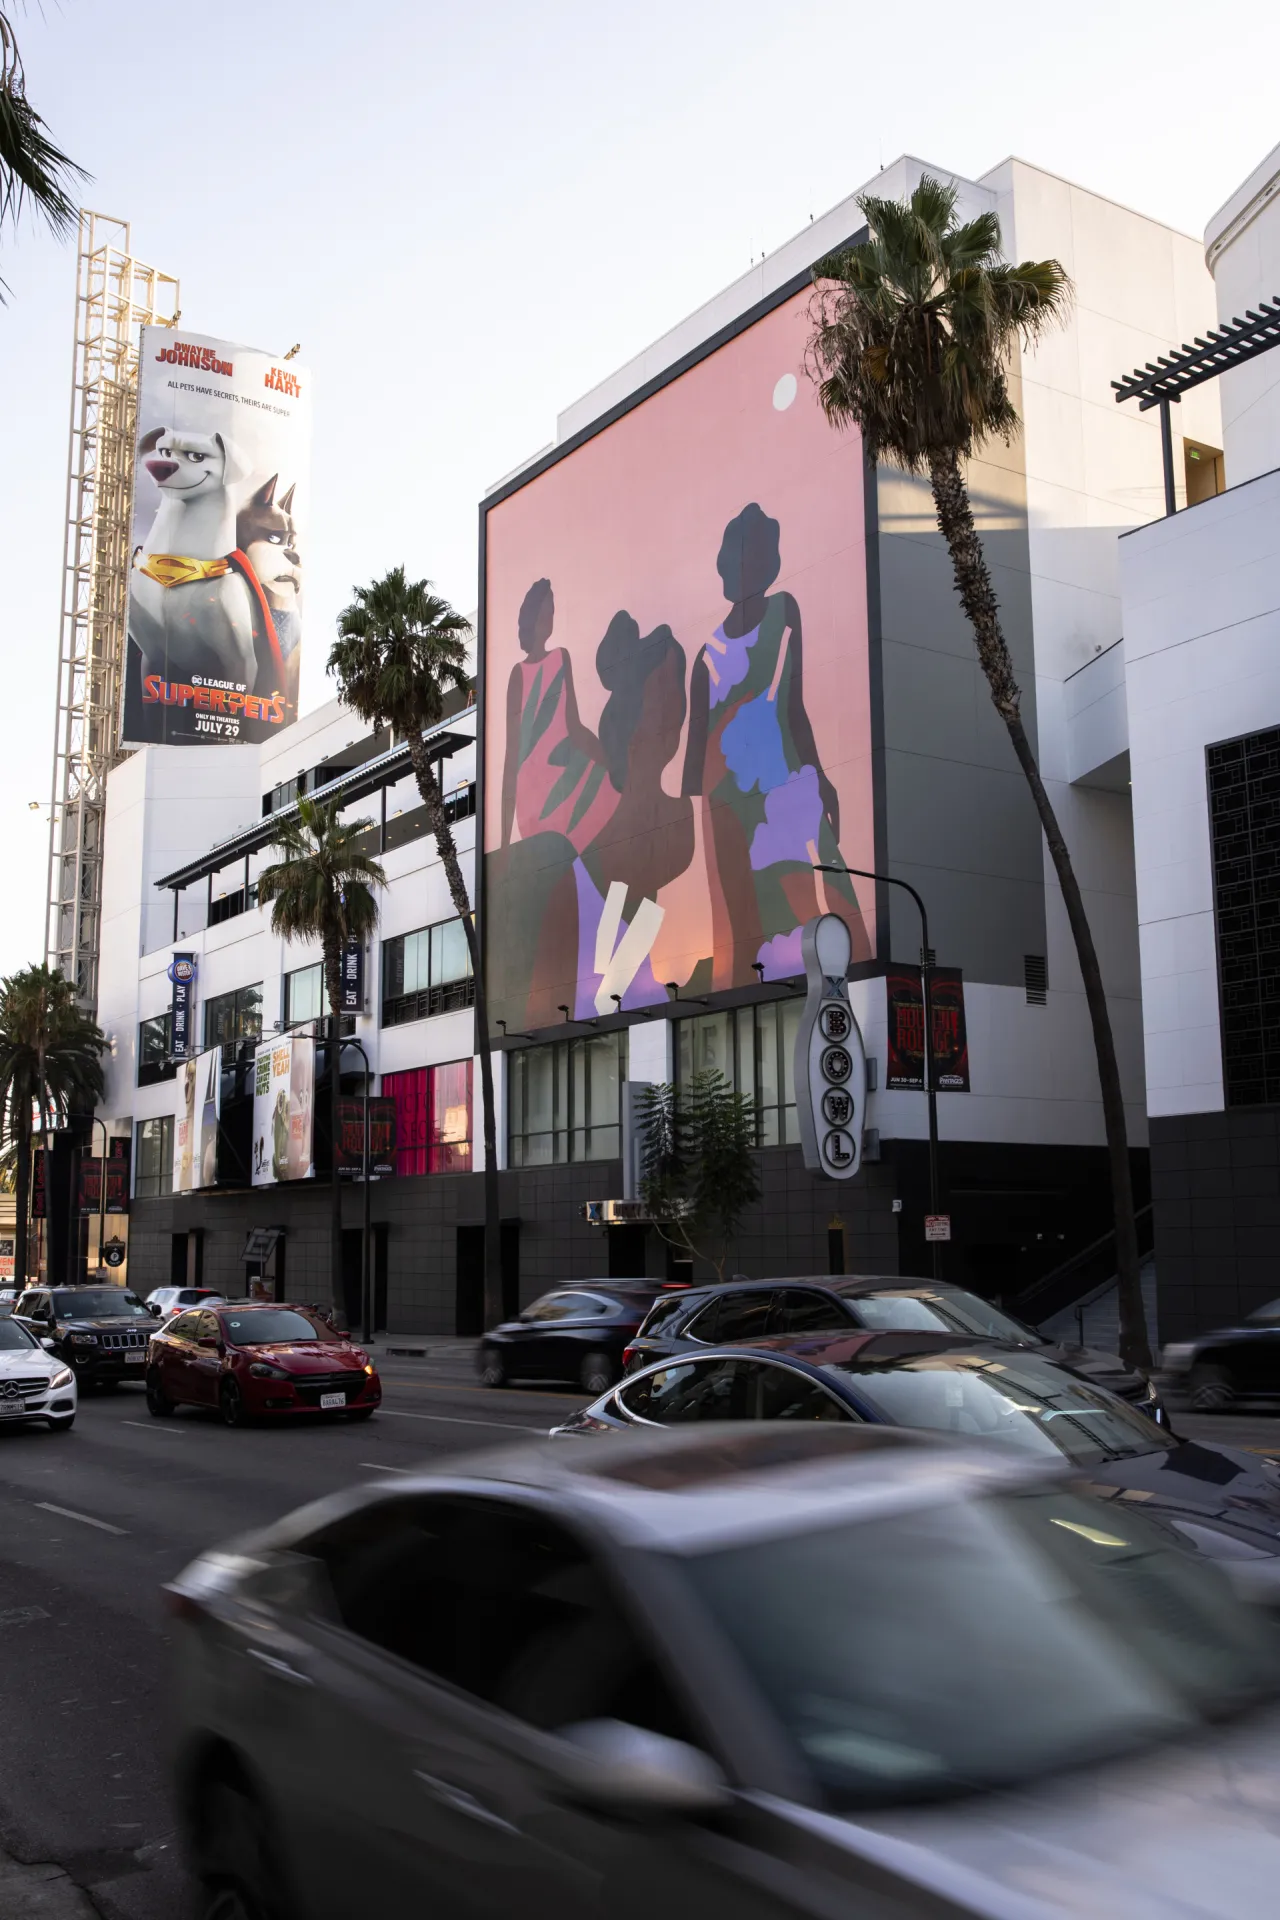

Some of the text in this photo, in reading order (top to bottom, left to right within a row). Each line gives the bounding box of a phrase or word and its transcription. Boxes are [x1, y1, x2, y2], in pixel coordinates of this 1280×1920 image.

[174, 341, 217, 360] DWAYNE
[155, 347, 234, 377] JOHNSON
[270, 367, 298, 384] KEVIN
[264, 373, 302, 398] HART
[167, 380, 179, 389] ALL
[180, 382, 195, 392] PETS
[196, 385, 213, 396] HAVE
[213, 389, 241, 403] SECRETS,
[241, 396, 261, 409] THEIRS
[261, 402, 272, 412] ARE
[203, 677, 235, 691] LEAGUE
[235, 682, 247, 692] OF
[195, 713, 209, 721] ONLY
[216, 715, 240, 725] THEATERS
[195, 720, 224, 734] JULY
[225, 724, 240, 737] 29
[346, 953, 358, 980] DRINK
[825, 976, 845, 998] X
[346, 990, 357, 1005] EAT
[174, 985, 186, 1053] EAT DRINK PLAY
[272, 1047, 290, 1063] SHELL
[272, 1060, 290, 1078] YEAH
[255, 1082, 270, 1097] NUTS
[826, 1010, 850, 1161] BOWL
